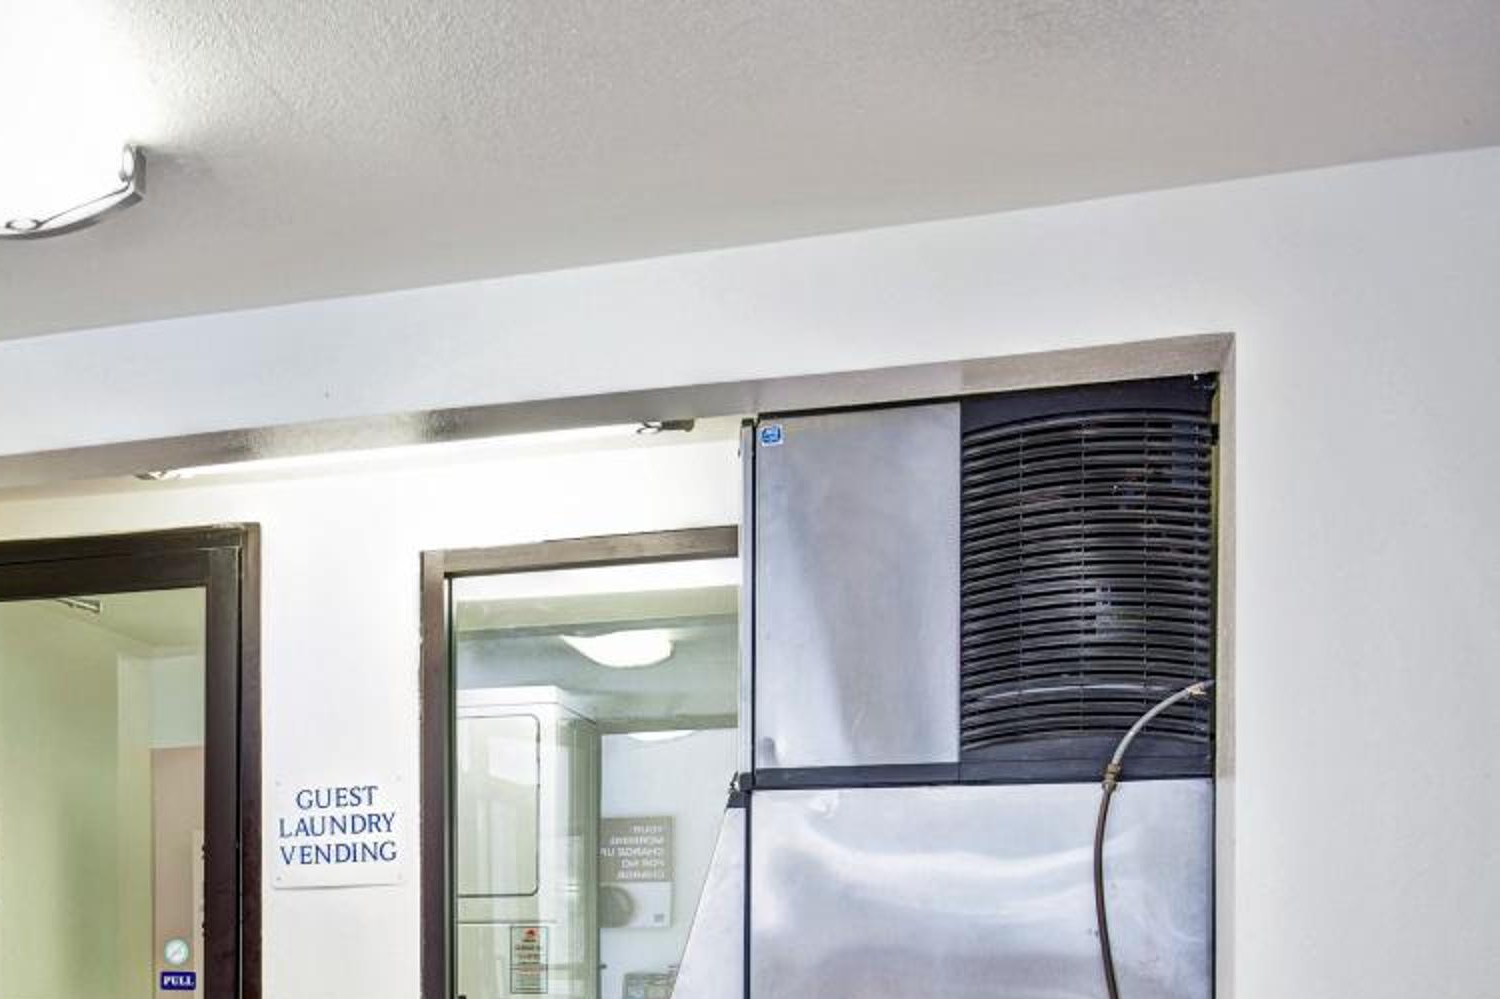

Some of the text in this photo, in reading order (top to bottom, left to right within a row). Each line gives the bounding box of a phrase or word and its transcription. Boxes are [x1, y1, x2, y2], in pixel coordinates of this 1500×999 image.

[296, 785, 378, 810] GUEST
[279, 812, 396, 838] LAUNDRY
[280, 841, 397, 865] VENDING
[163, 975, 195, 987] PULL
